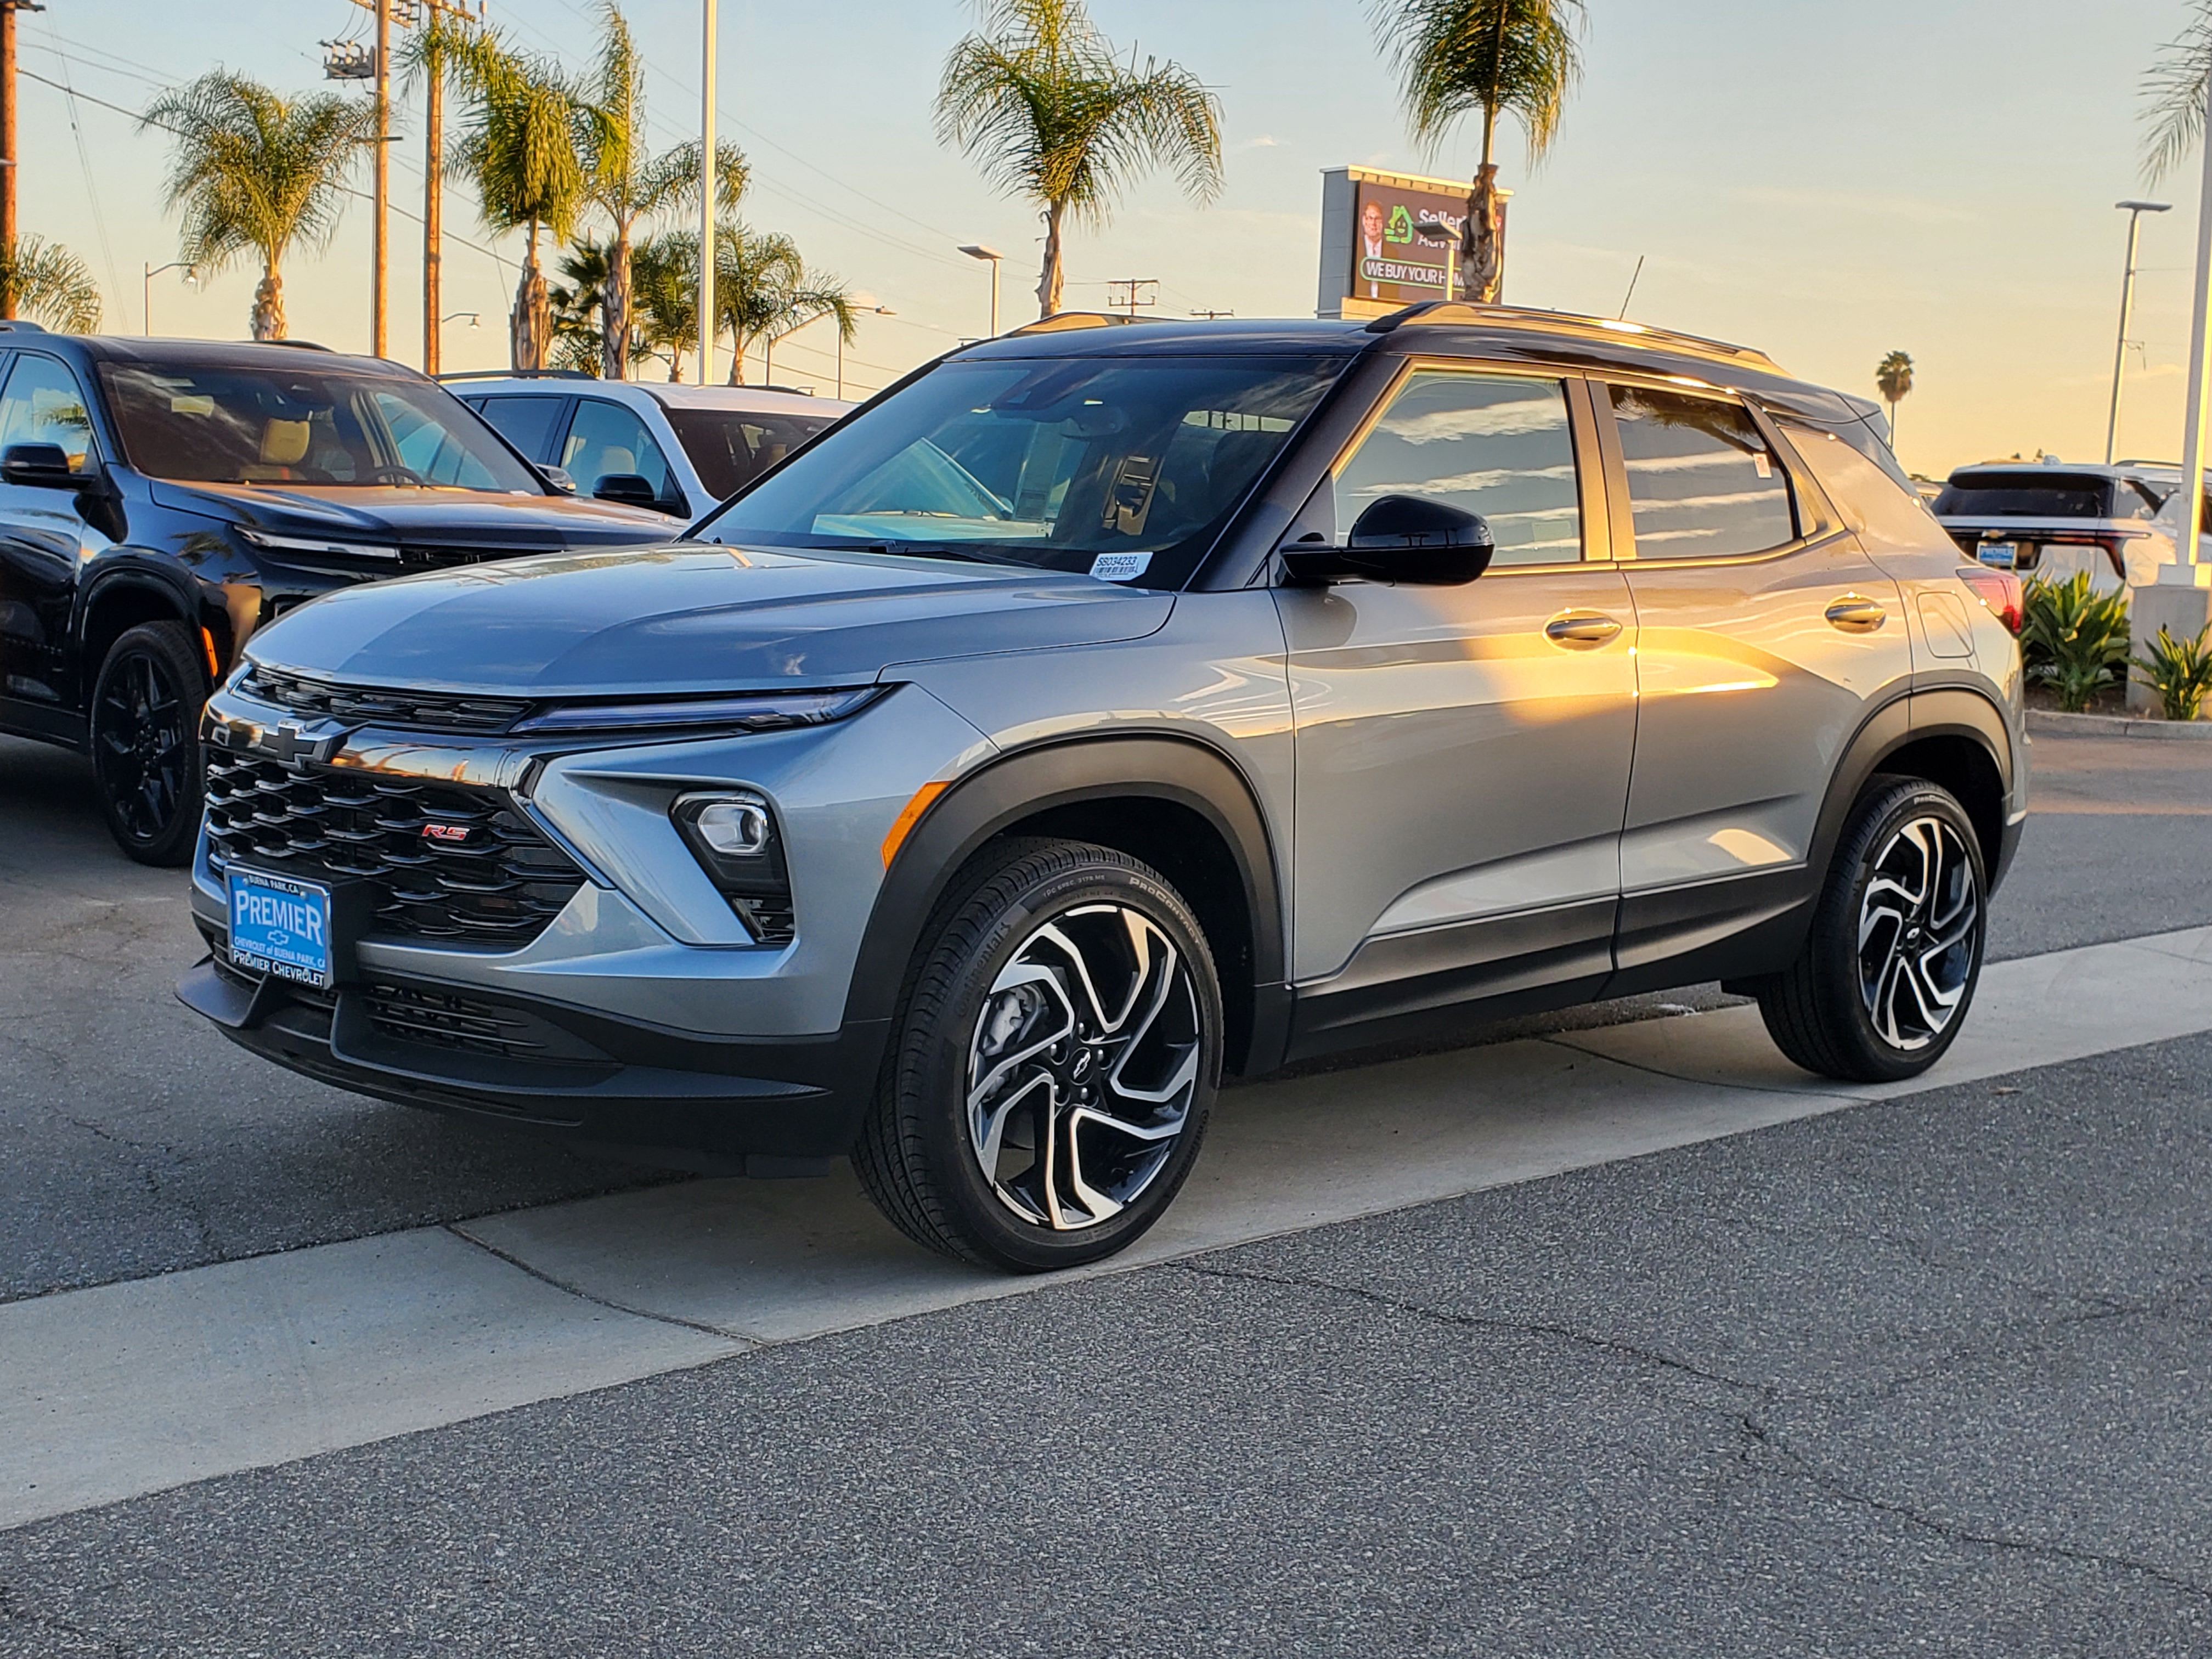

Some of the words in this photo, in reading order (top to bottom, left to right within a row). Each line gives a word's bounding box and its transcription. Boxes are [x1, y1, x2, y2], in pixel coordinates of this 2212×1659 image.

[1366, 261, 1384, 276] WE
[1385, 264, 1407, 280] BUY
[1408, 266, 1437, 284] YOUR
[421, 824, 470, 840] RS
[248, 874, 269, 887] BUENA
[235, 890, 324, 947] PREMIER
[234, 936, 266, 953] CHEVROLET
[267, 945, 273, 954] of
[274, 946, 295, 961] BUENA
[234, 949, 270, 972] PREMIER
[272, 961, 324, 987] CHEVROLET
